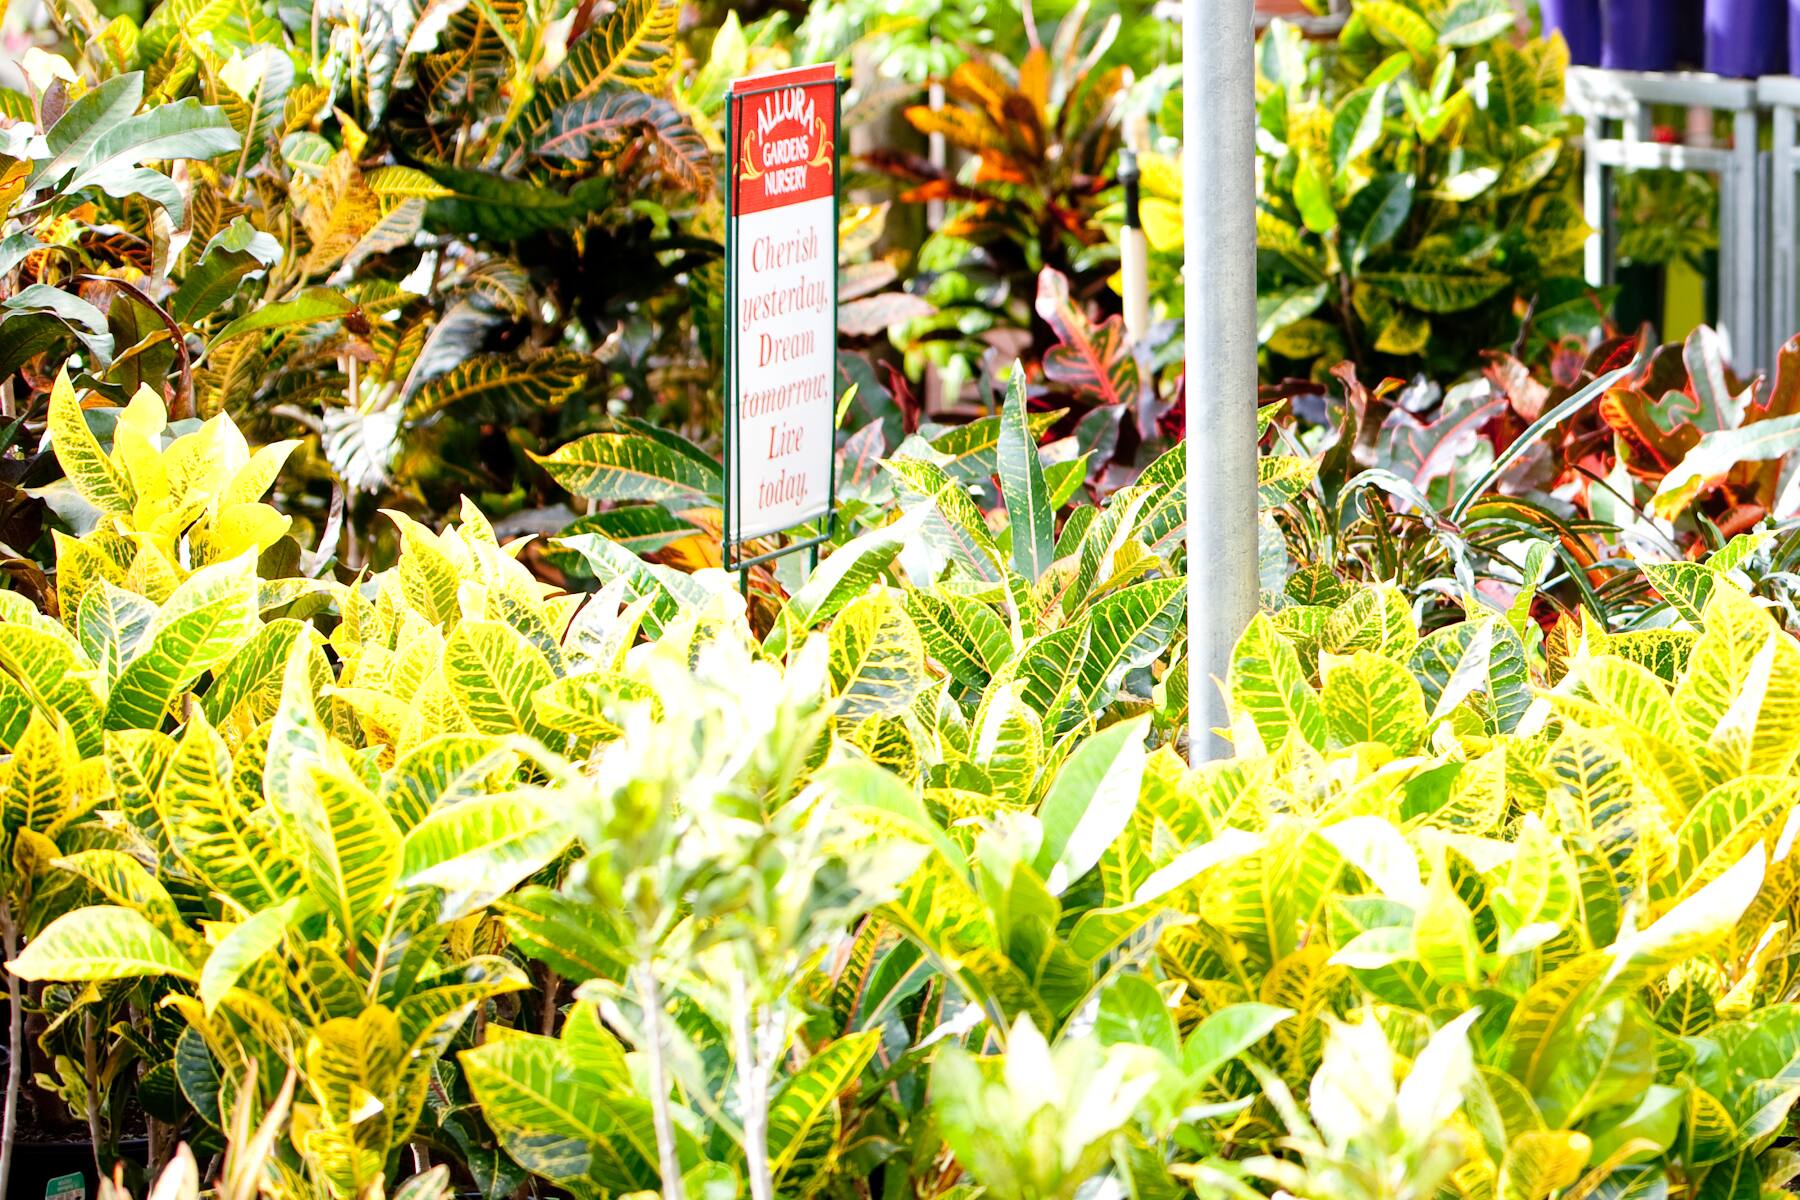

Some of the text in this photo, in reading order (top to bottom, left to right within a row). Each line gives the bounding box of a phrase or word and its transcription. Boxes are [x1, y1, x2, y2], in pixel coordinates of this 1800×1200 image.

[757, 84, 815, 147] ALLORA
[762, 135, 810, 168] GARDENS
[764, 164, 808, 197] NURSERY
[752, 225, 818, 273] Cherish
[758, 329, 815, 368] Dream
[768, 422, 804, 460] Live
[758, 468, 808, 510] today.
